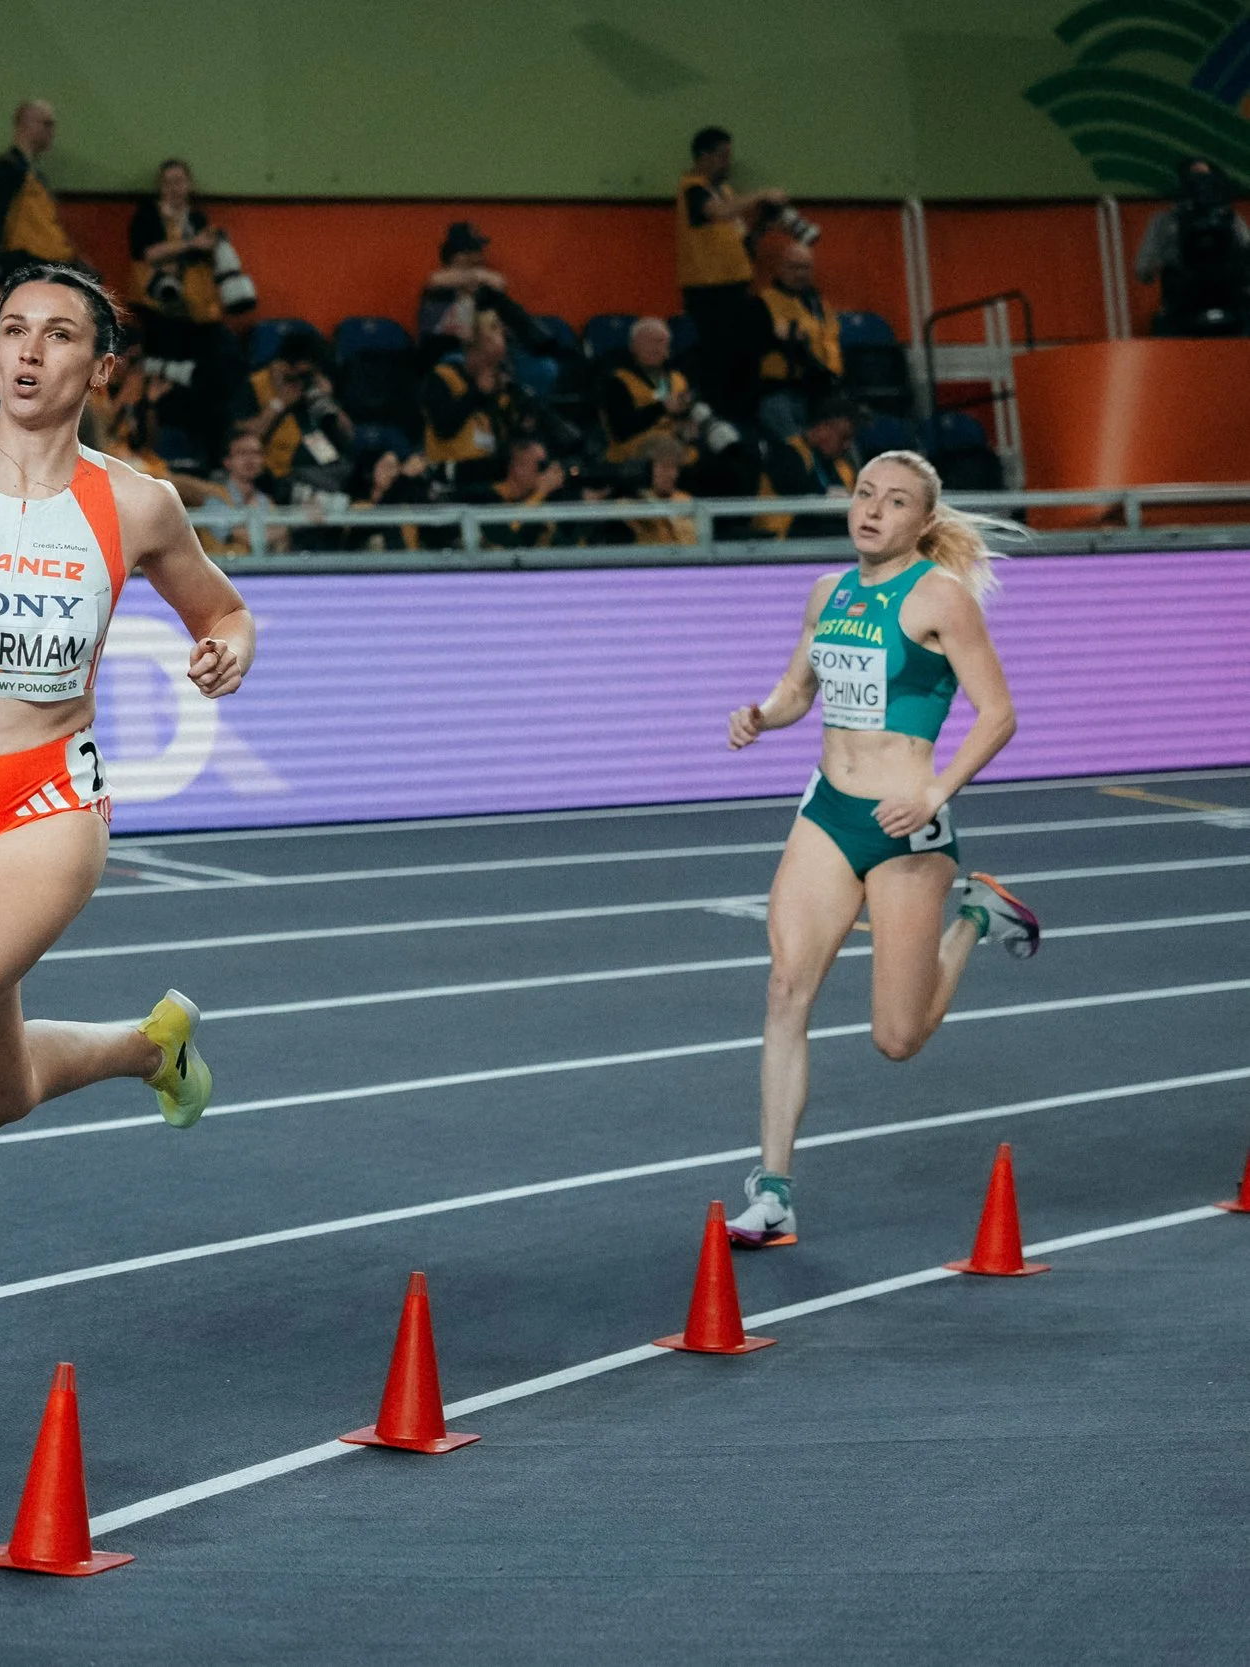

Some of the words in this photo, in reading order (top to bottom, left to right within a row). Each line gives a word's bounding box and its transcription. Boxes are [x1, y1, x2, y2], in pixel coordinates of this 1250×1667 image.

[64, 544, 88, 553] Mutuel
[815, 618, 883, 646] USTRALIA
[811, 650, 873, 672] SONY
[18, 682, 67, 693] POMORZE
[68, 680, 78, 690] 26
[78, 741, 104, 792] 2
